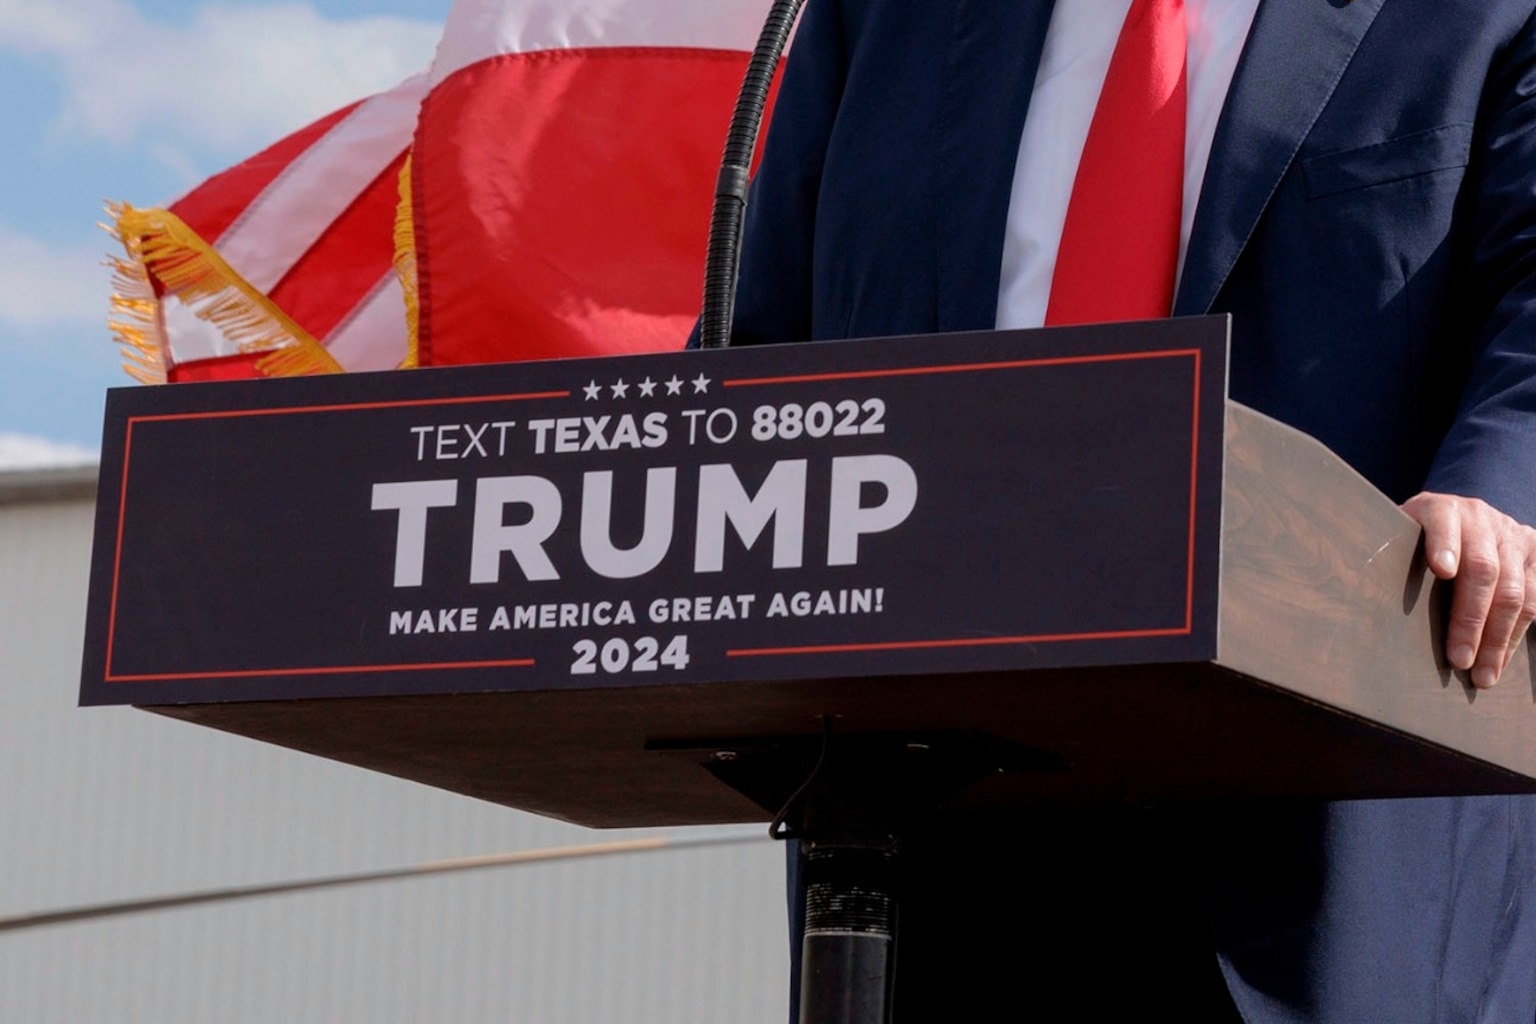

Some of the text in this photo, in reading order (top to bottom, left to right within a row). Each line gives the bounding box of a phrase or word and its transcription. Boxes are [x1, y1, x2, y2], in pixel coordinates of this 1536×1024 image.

[410, 398, 886, 461] TEXT TEXAS TO 88022
[370, 454, 918, 588] TRUMP
[389, 587, 884, 635] MAKE AMERICA GREAT AGAIN!
[570, 635, 690, 675] 2024
